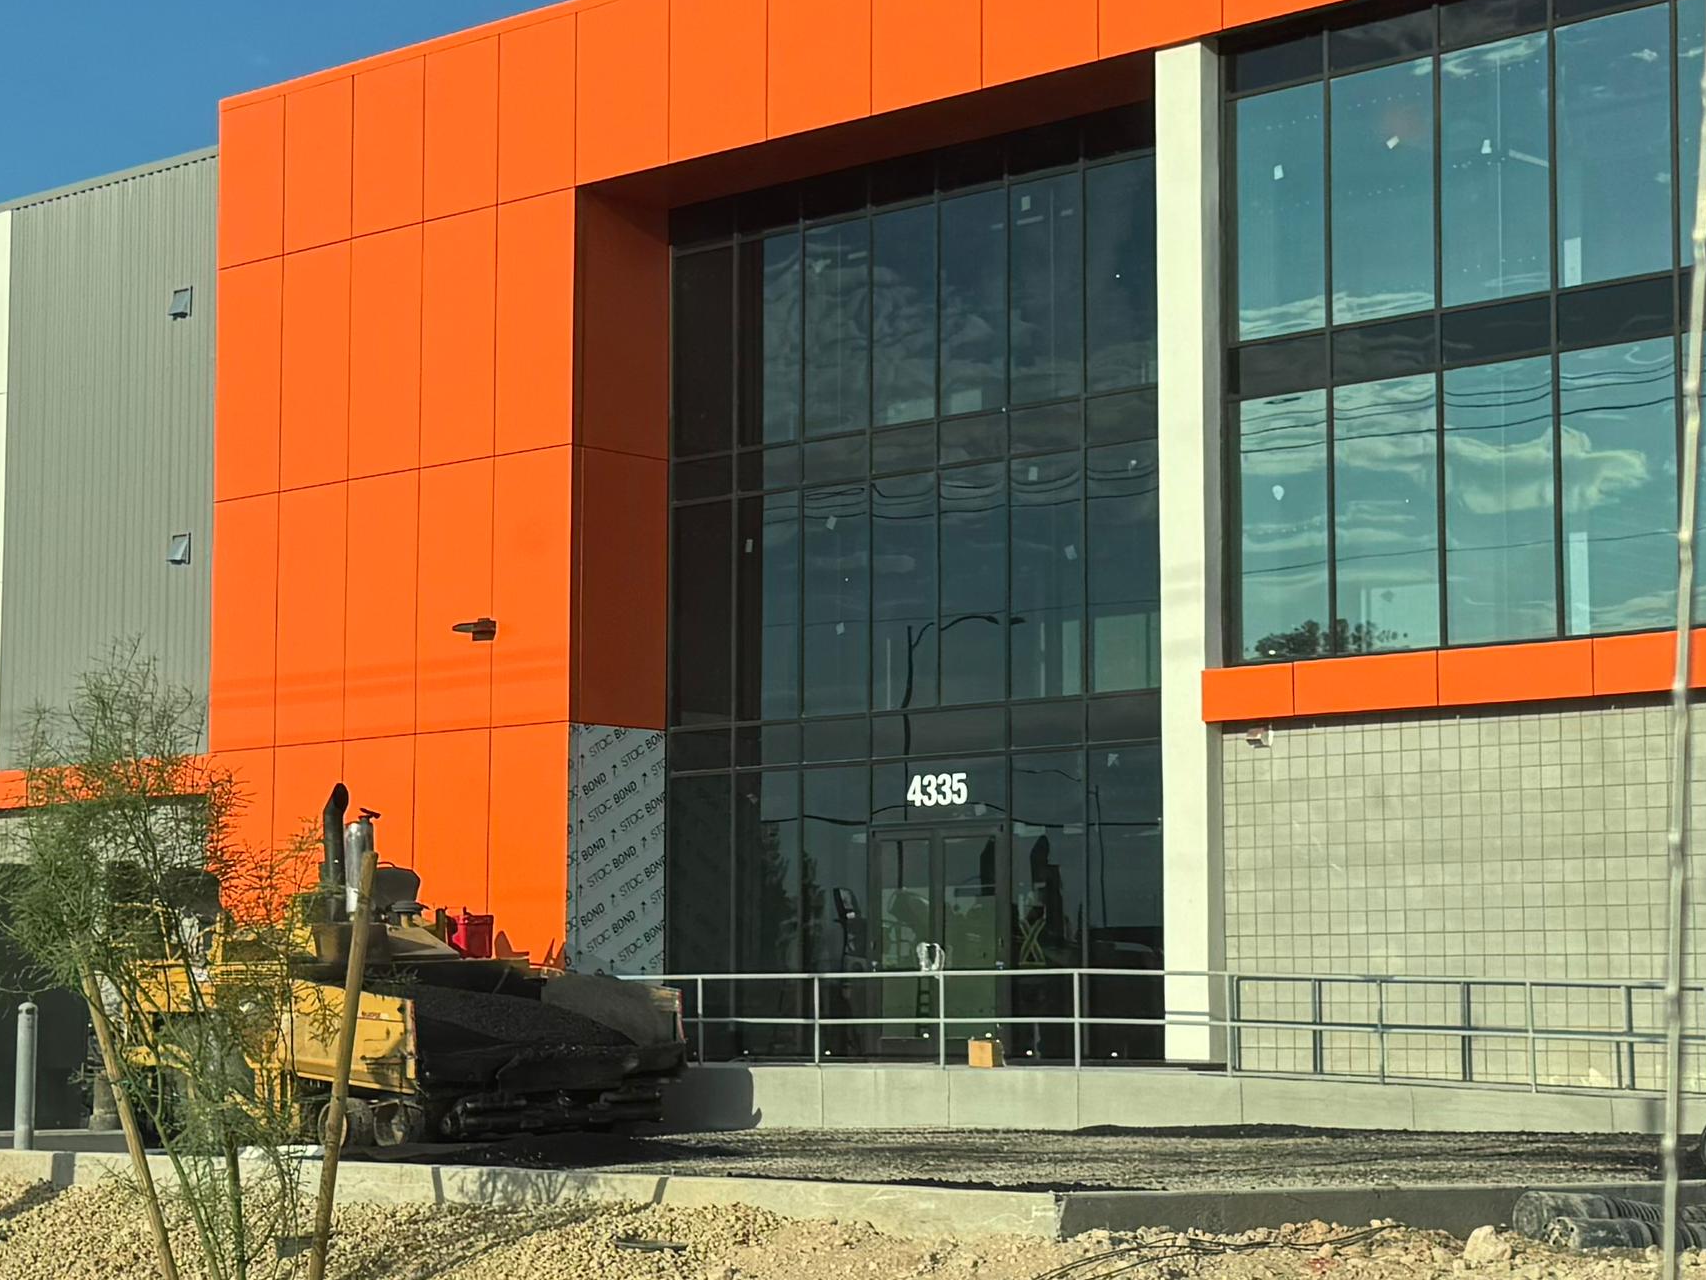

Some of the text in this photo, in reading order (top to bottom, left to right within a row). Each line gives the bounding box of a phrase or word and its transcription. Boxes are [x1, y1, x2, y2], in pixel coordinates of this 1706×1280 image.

[582, 772, 606, 795] BOND
[613, 781, 637, 804] BOND
[906, 772, 968, 807] 4335
[581, 839, 605, 861] BOND
[613, 846, 636, 868] BOND
[581, 902, 605, 926] BOND
[612, 910, 636, 933] BOND
